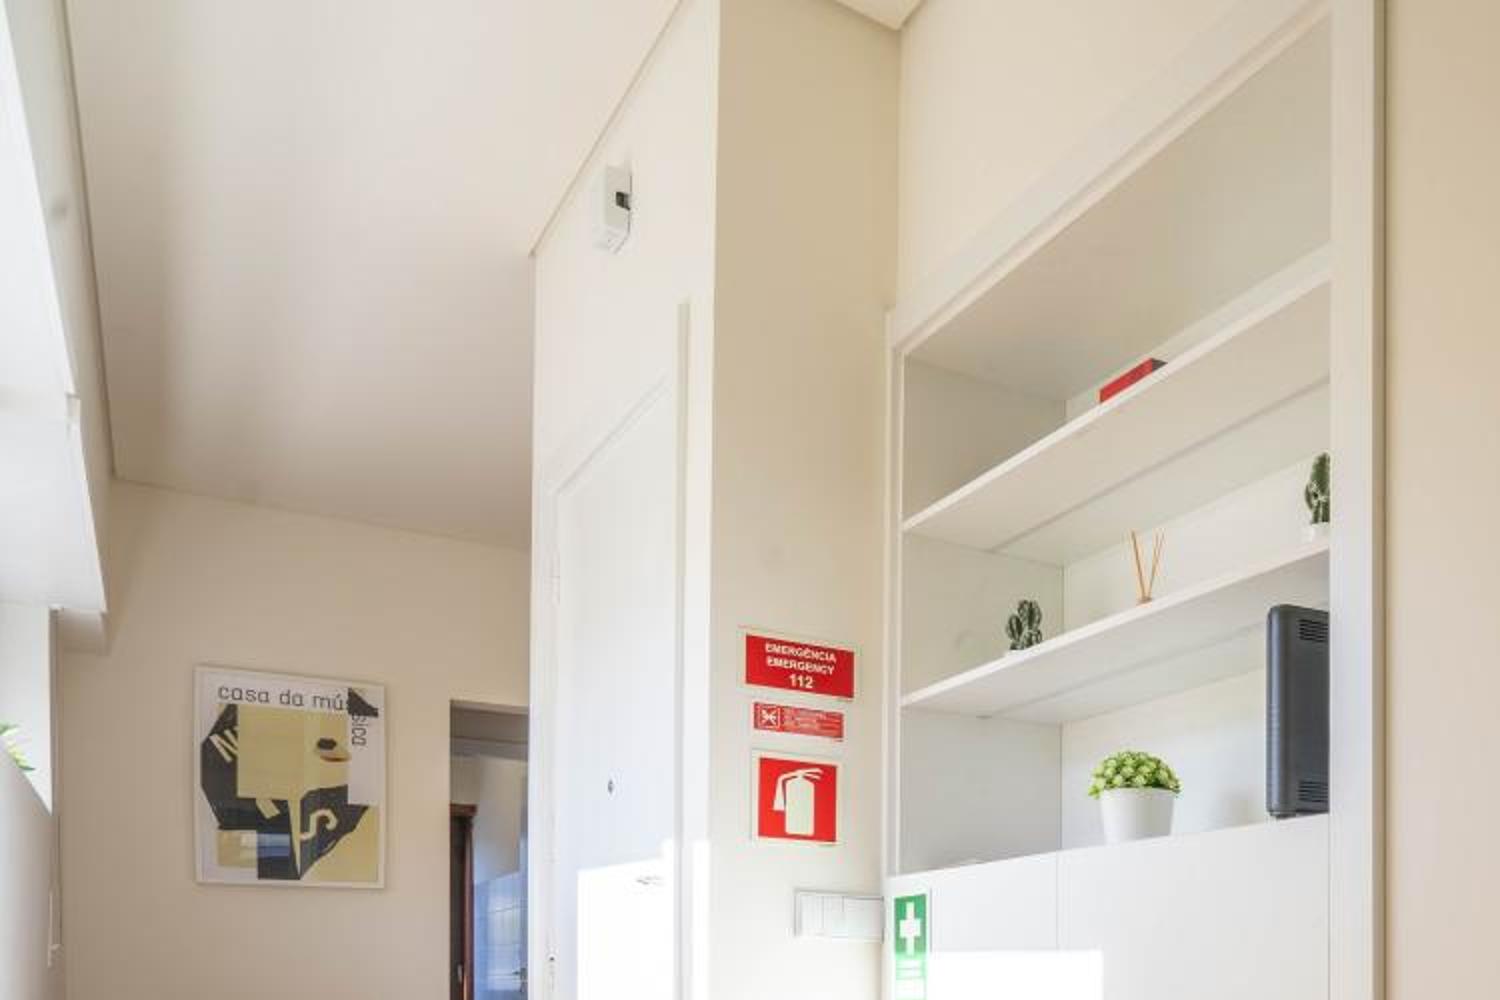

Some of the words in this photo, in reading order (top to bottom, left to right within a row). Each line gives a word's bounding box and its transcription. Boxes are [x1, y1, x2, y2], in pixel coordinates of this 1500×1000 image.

[766, 656, 834, 675] EMERGENCY
[789, 673, 813, 689] 112
[217, 686, 270, 704] casa
[279, 689, 304, 707] da
